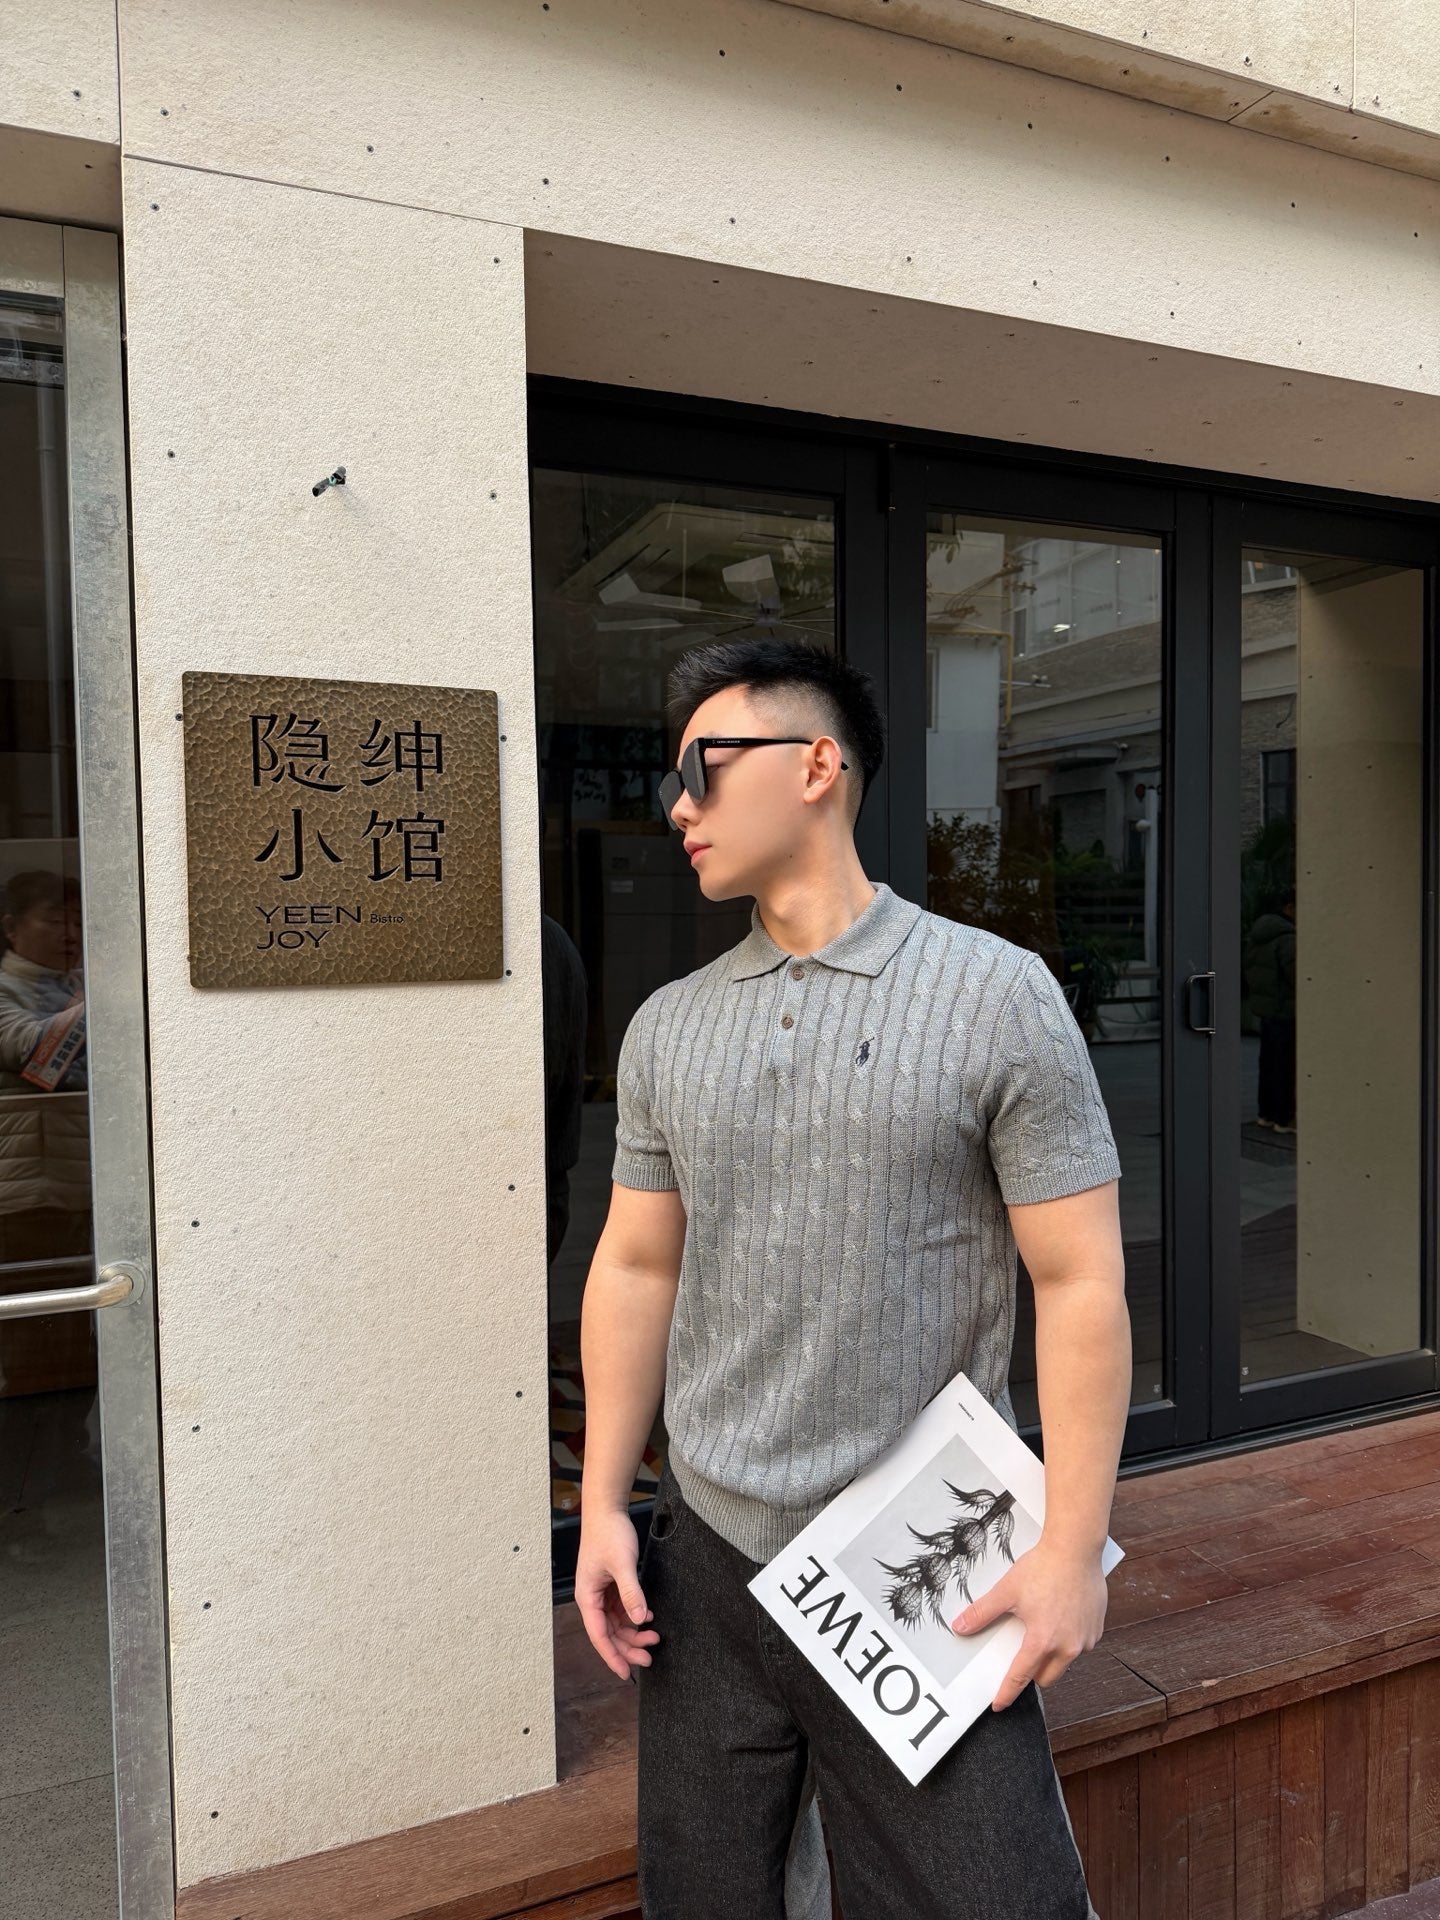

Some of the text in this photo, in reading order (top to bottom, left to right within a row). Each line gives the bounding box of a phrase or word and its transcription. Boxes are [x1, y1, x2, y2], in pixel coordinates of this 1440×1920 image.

[249, 713, 443, 792] 隐绅
[254, 809, 445, 884] 小馆
[255, 906, 404, 924] YEEN Bistro
[256, 930, 330, 949] JOY
[780, 1556, 950, 1751] LOEWE
